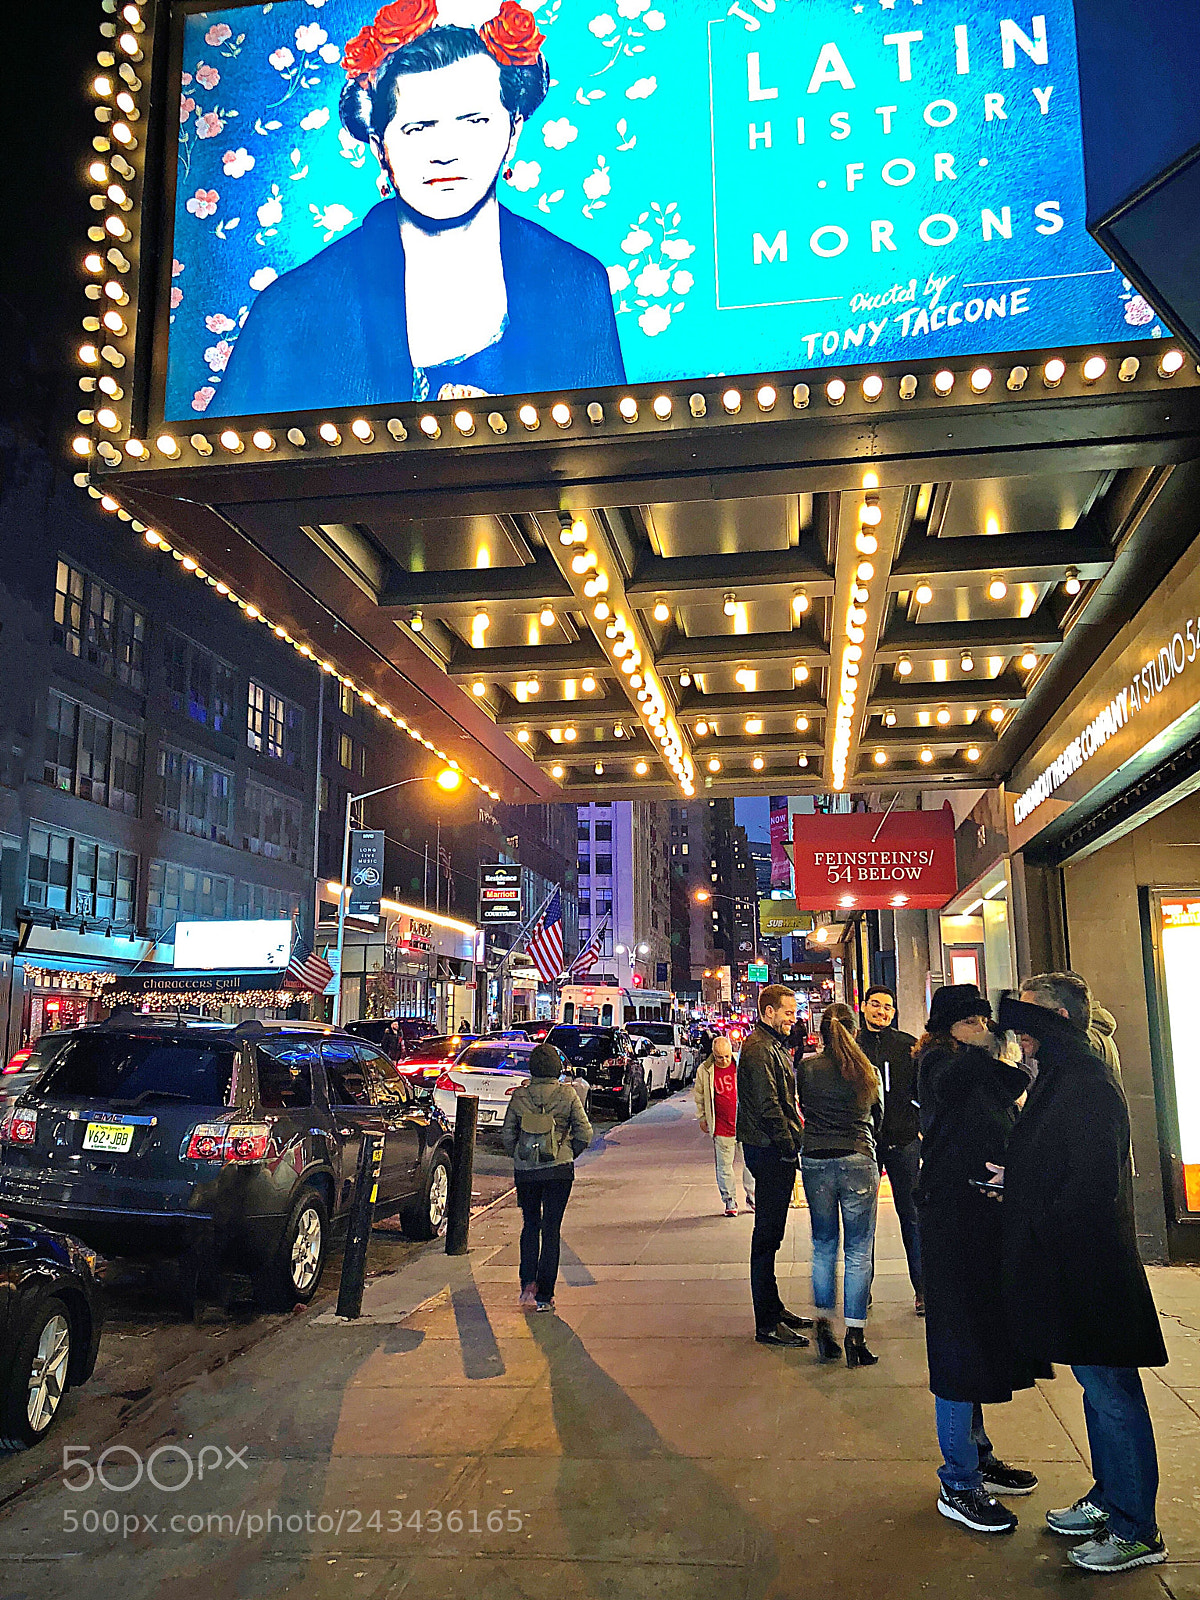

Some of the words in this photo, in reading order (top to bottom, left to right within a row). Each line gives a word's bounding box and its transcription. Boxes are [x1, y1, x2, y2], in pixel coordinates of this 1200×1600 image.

[746, 14, 1050, 102] LATIN
[747, 85, 1055, 151] HISTORY
[845, 151, 959, 192] FOR
[752, 199, 1065, 266] MORONS
[849, 278, 916, 313] Directed
[922, 272, 956, 310] by
[801, 317, 888, 360] TONY
[893, 287, 1031, 338] TACCONE
[1080, 687, 1129, 761] COMPANY
[1130, 674, 1142, 718] AT
[1141, 632, 1186, 705] STUDIO
[770, 814, 787, 825] NOW
[813, 849, 935, 866] FEINSTEIN'S/
[827, 865, 854, 884] 54
[857, 866, 923, 881] BELOW
[486, 890, 516, 898] Marriott
[766, 919, 801, 928] SUBWAY
[714, 1072, 737, 1095] US
